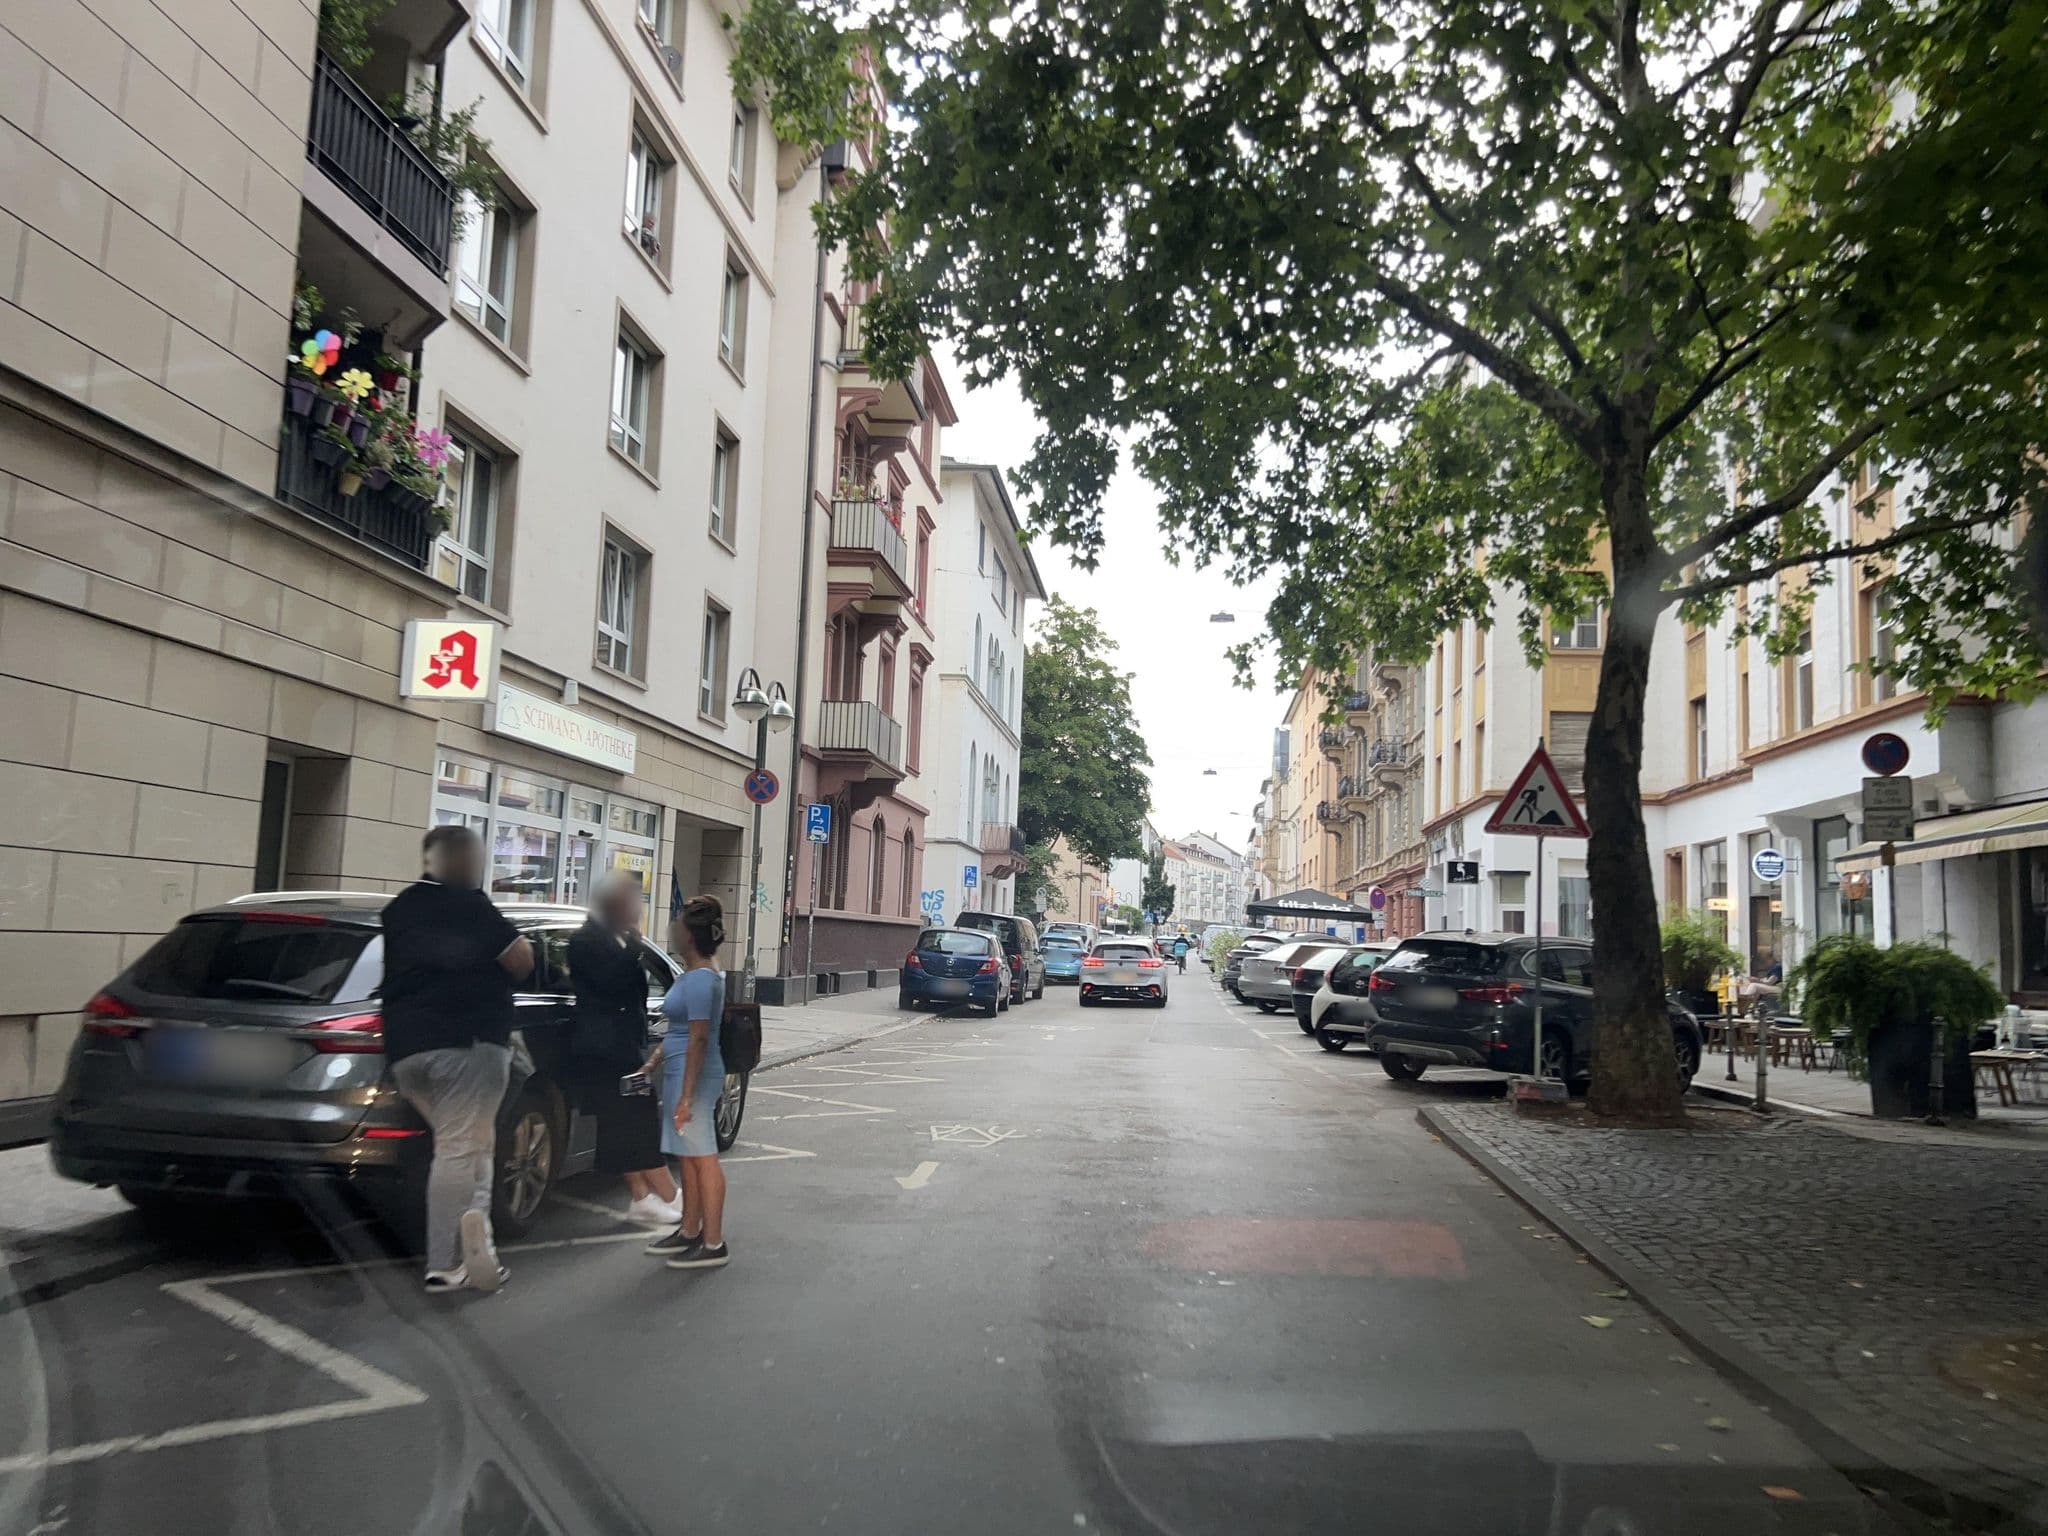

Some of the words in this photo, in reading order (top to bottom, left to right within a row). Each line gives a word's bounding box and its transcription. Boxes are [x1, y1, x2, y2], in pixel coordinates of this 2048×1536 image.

[523, 705, 583, 743] SCHWANEN
[585, 728, 633, 760] APOTHEKE
[811, 807, 821, 821] P
[1277, 899, 1351, 911] fritz-kola
